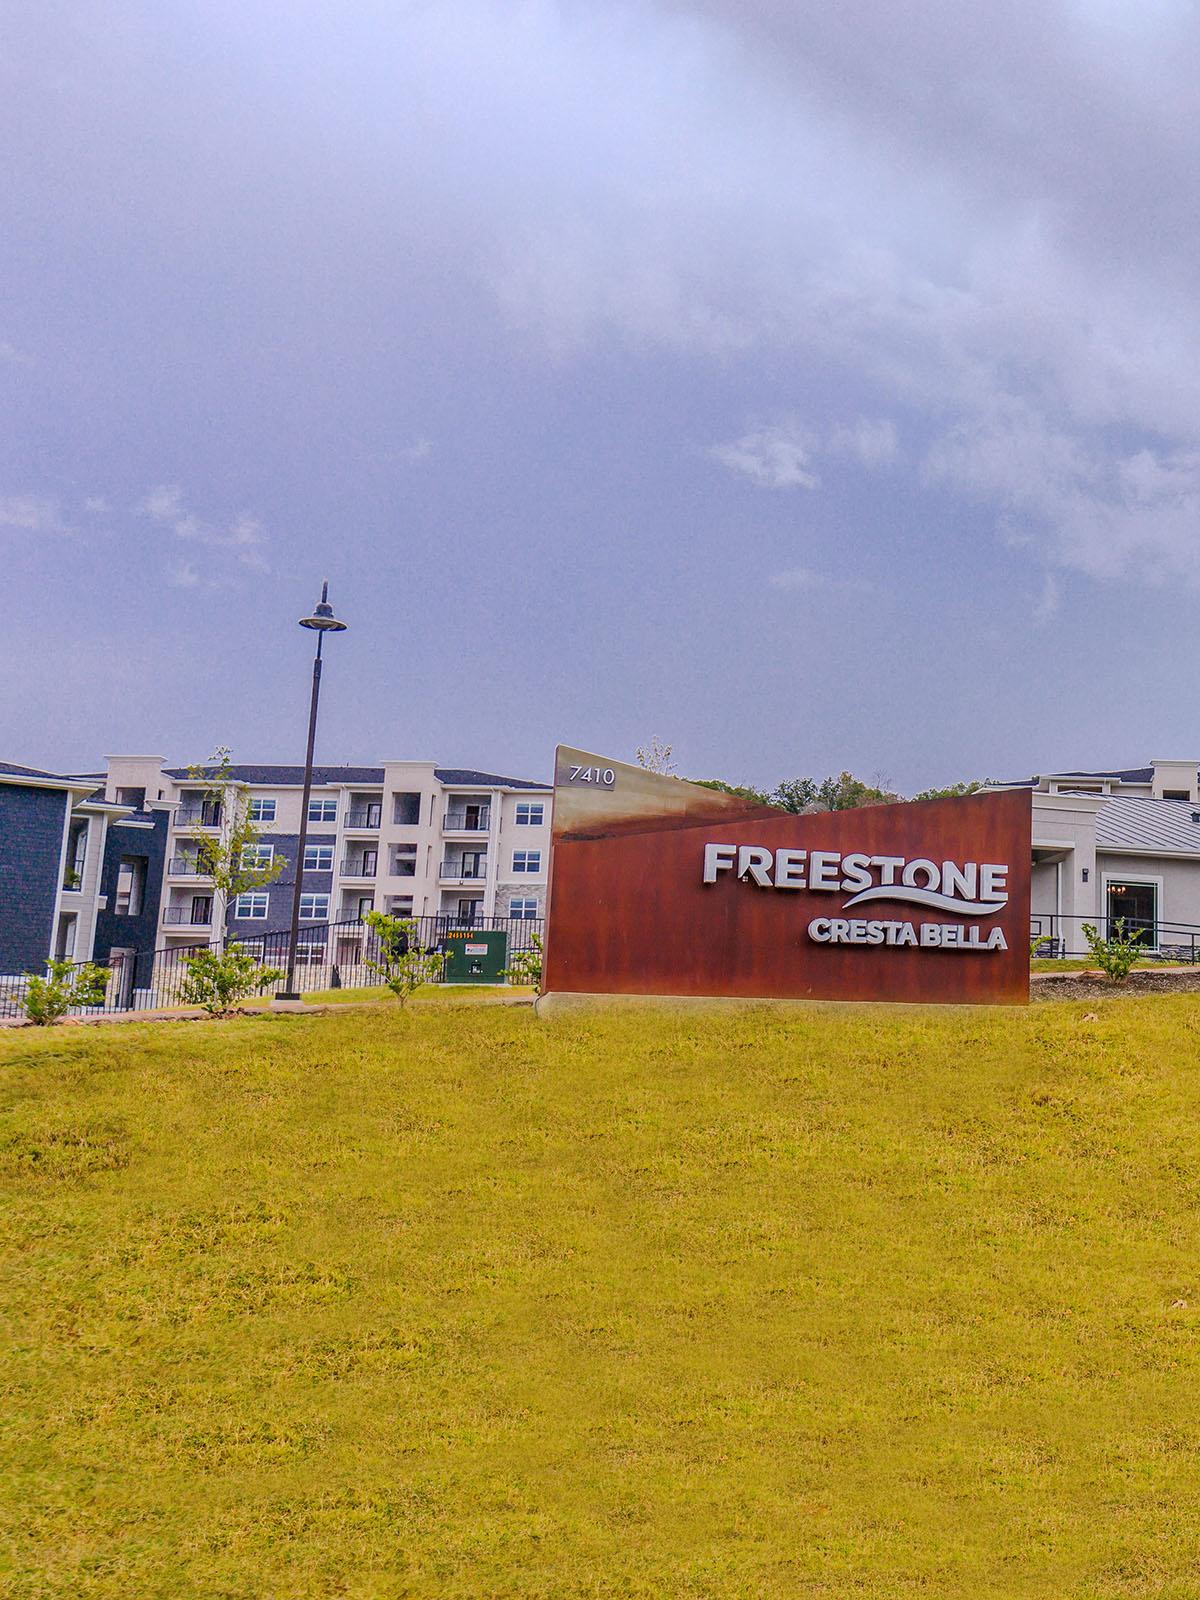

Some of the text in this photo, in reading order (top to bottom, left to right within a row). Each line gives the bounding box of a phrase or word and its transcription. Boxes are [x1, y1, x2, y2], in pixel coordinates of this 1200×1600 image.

[569, 765, 615, 785] 7410
[703, 843, 1009, 902] FREESTONE
[808, 917, 1008, 950] CRESTA BELLA
